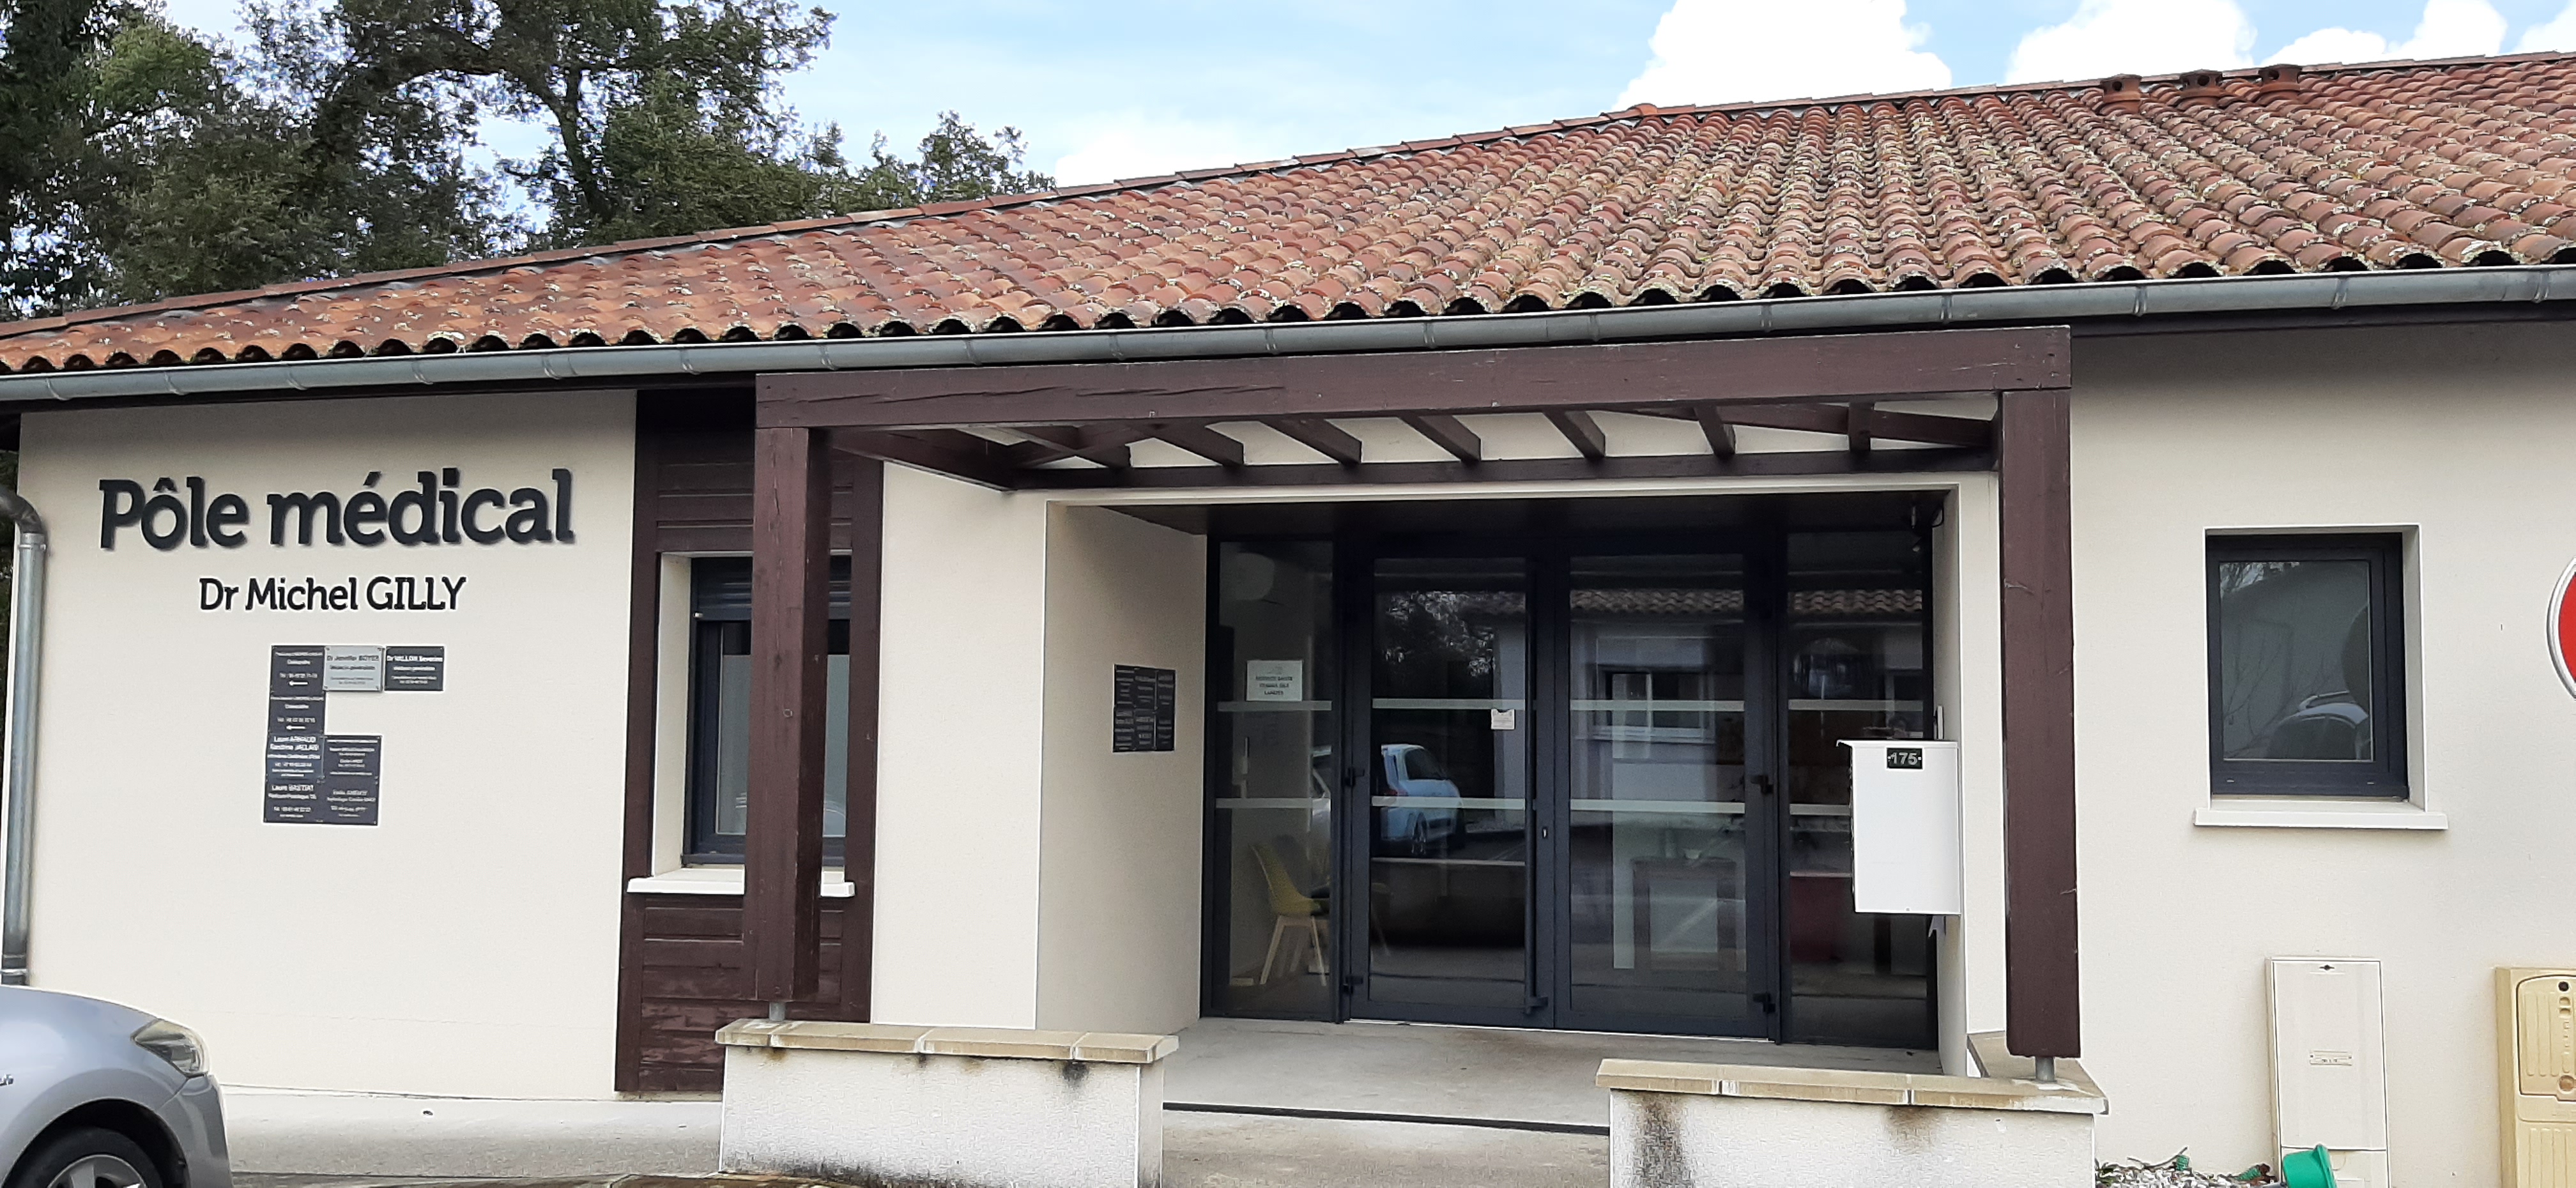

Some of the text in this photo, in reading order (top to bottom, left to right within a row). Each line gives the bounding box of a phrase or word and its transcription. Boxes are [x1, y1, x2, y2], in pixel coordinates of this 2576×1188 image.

[99, 468, 574, 550] Pôle médical
[199, 576, 466, 611] Dr Michel GILLY
[1890, 752, 1918, 765] 175
